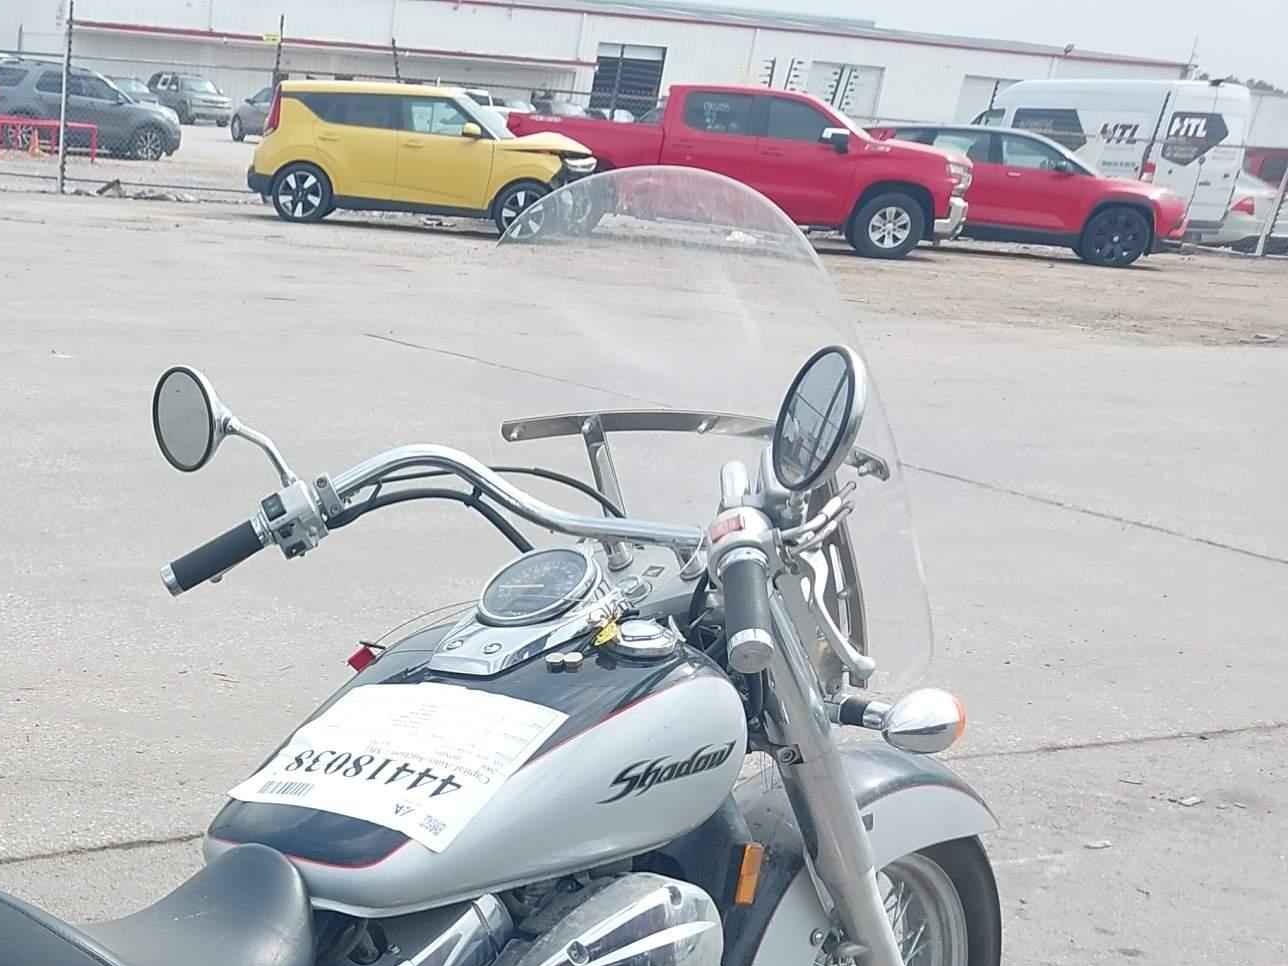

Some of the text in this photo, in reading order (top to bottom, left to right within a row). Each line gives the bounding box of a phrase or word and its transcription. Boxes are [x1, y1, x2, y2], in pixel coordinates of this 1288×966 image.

[1169, 117, 1208, 137] HTL
[285, 750, 462, 797] 44418038
[596, 740, 737, 804] Shadow
